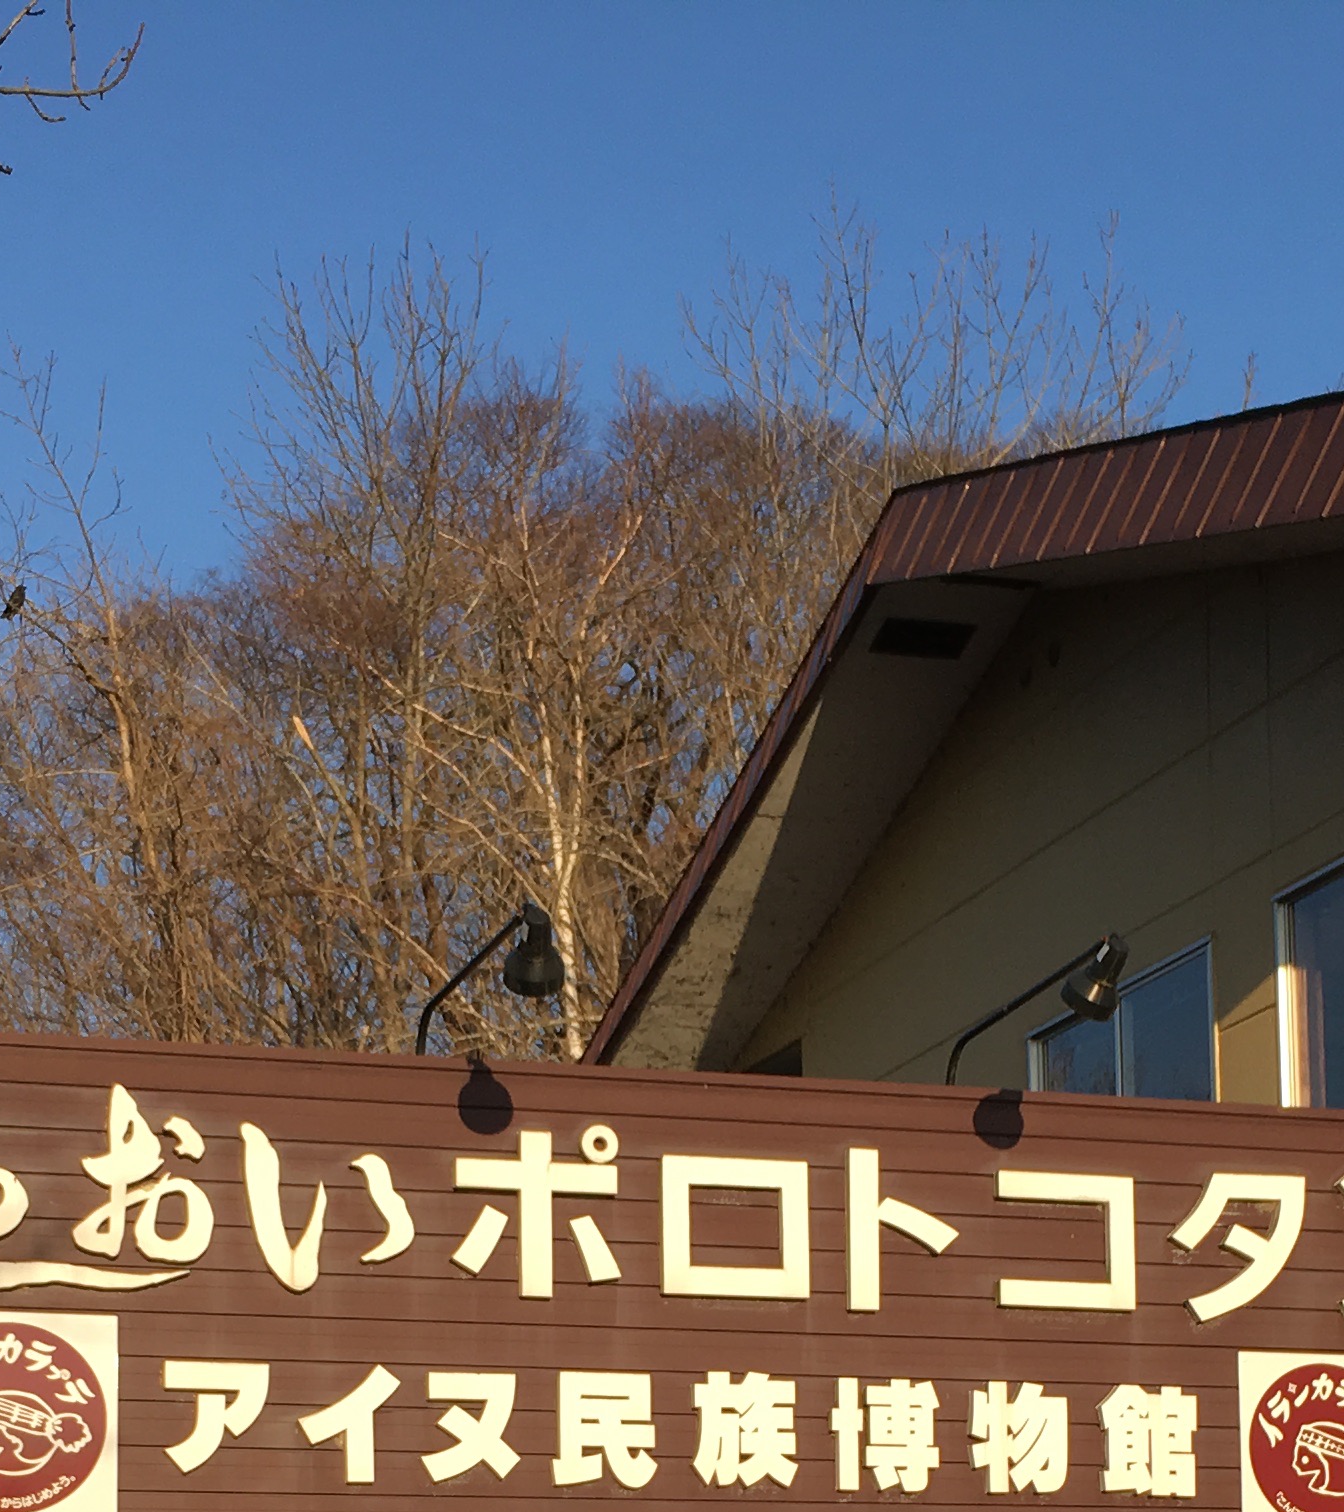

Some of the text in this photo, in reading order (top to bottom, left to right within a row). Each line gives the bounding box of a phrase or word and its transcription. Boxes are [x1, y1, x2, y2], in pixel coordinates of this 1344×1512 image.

[162, 1360, 1200, 1498] アイヌ民族博物館
